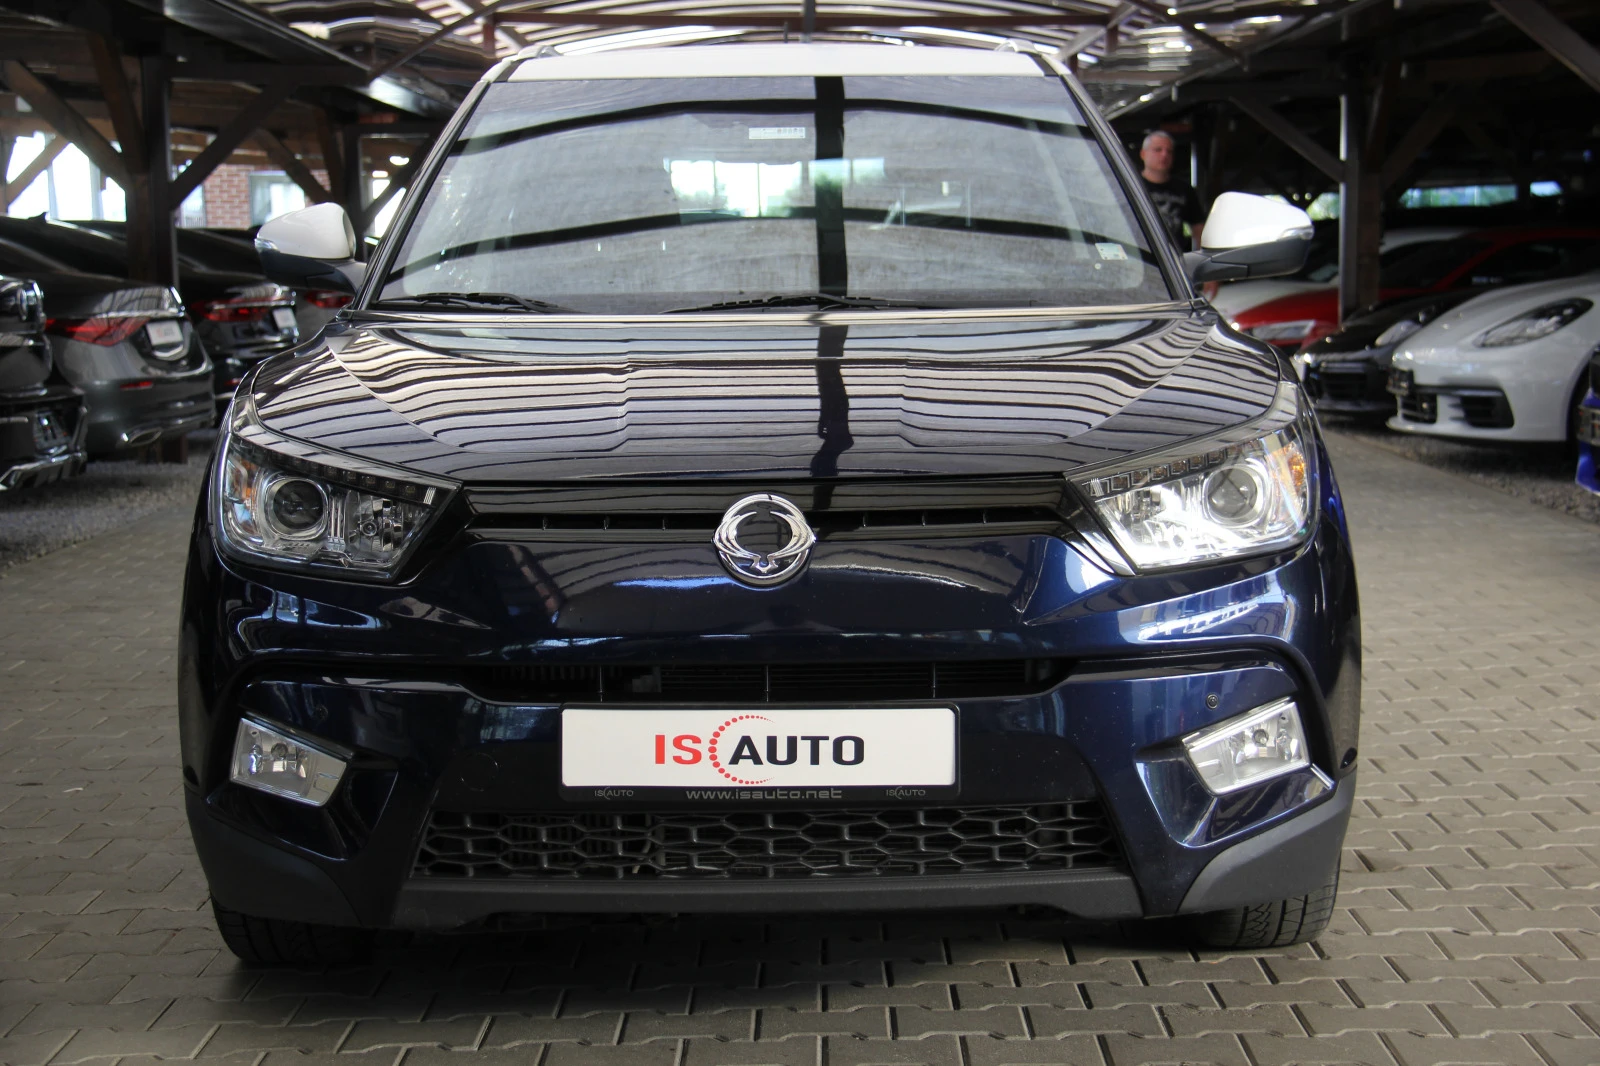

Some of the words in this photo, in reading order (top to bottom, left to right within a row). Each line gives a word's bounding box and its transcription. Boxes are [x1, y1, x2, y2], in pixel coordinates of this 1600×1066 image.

[654, 734, 703, 765] IS
[728, 735, 865, 766] AUTO
[685, 788, 843, 800] www.isauto.net
